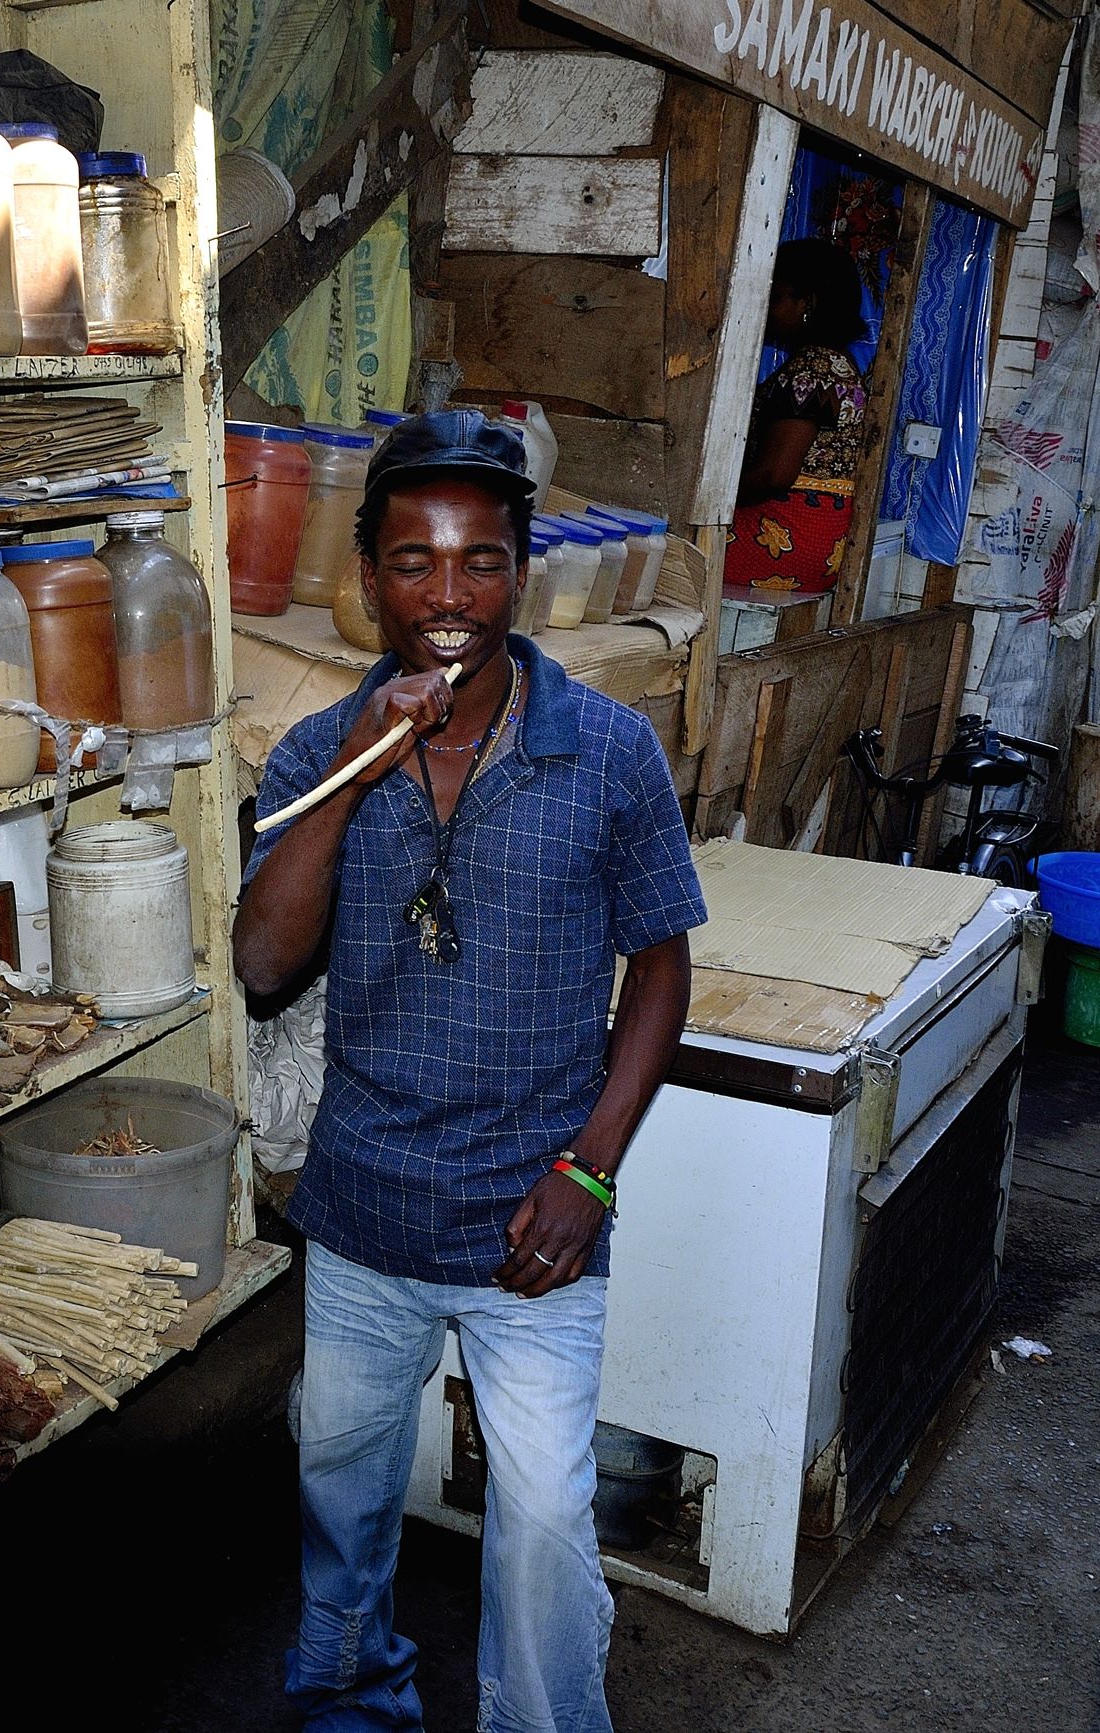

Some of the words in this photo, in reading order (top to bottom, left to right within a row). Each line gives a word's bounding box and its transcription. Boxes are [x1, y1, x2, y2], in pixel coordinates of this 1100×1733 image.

[713, 0, 870, 117] SAMAKI
[867, 38, 964, 168] WABICHI
[969, 107, 1023, 199] KUKU
[353, 239, 378, 352] SIMBA
[28, 769, 86, 801] LAIER
